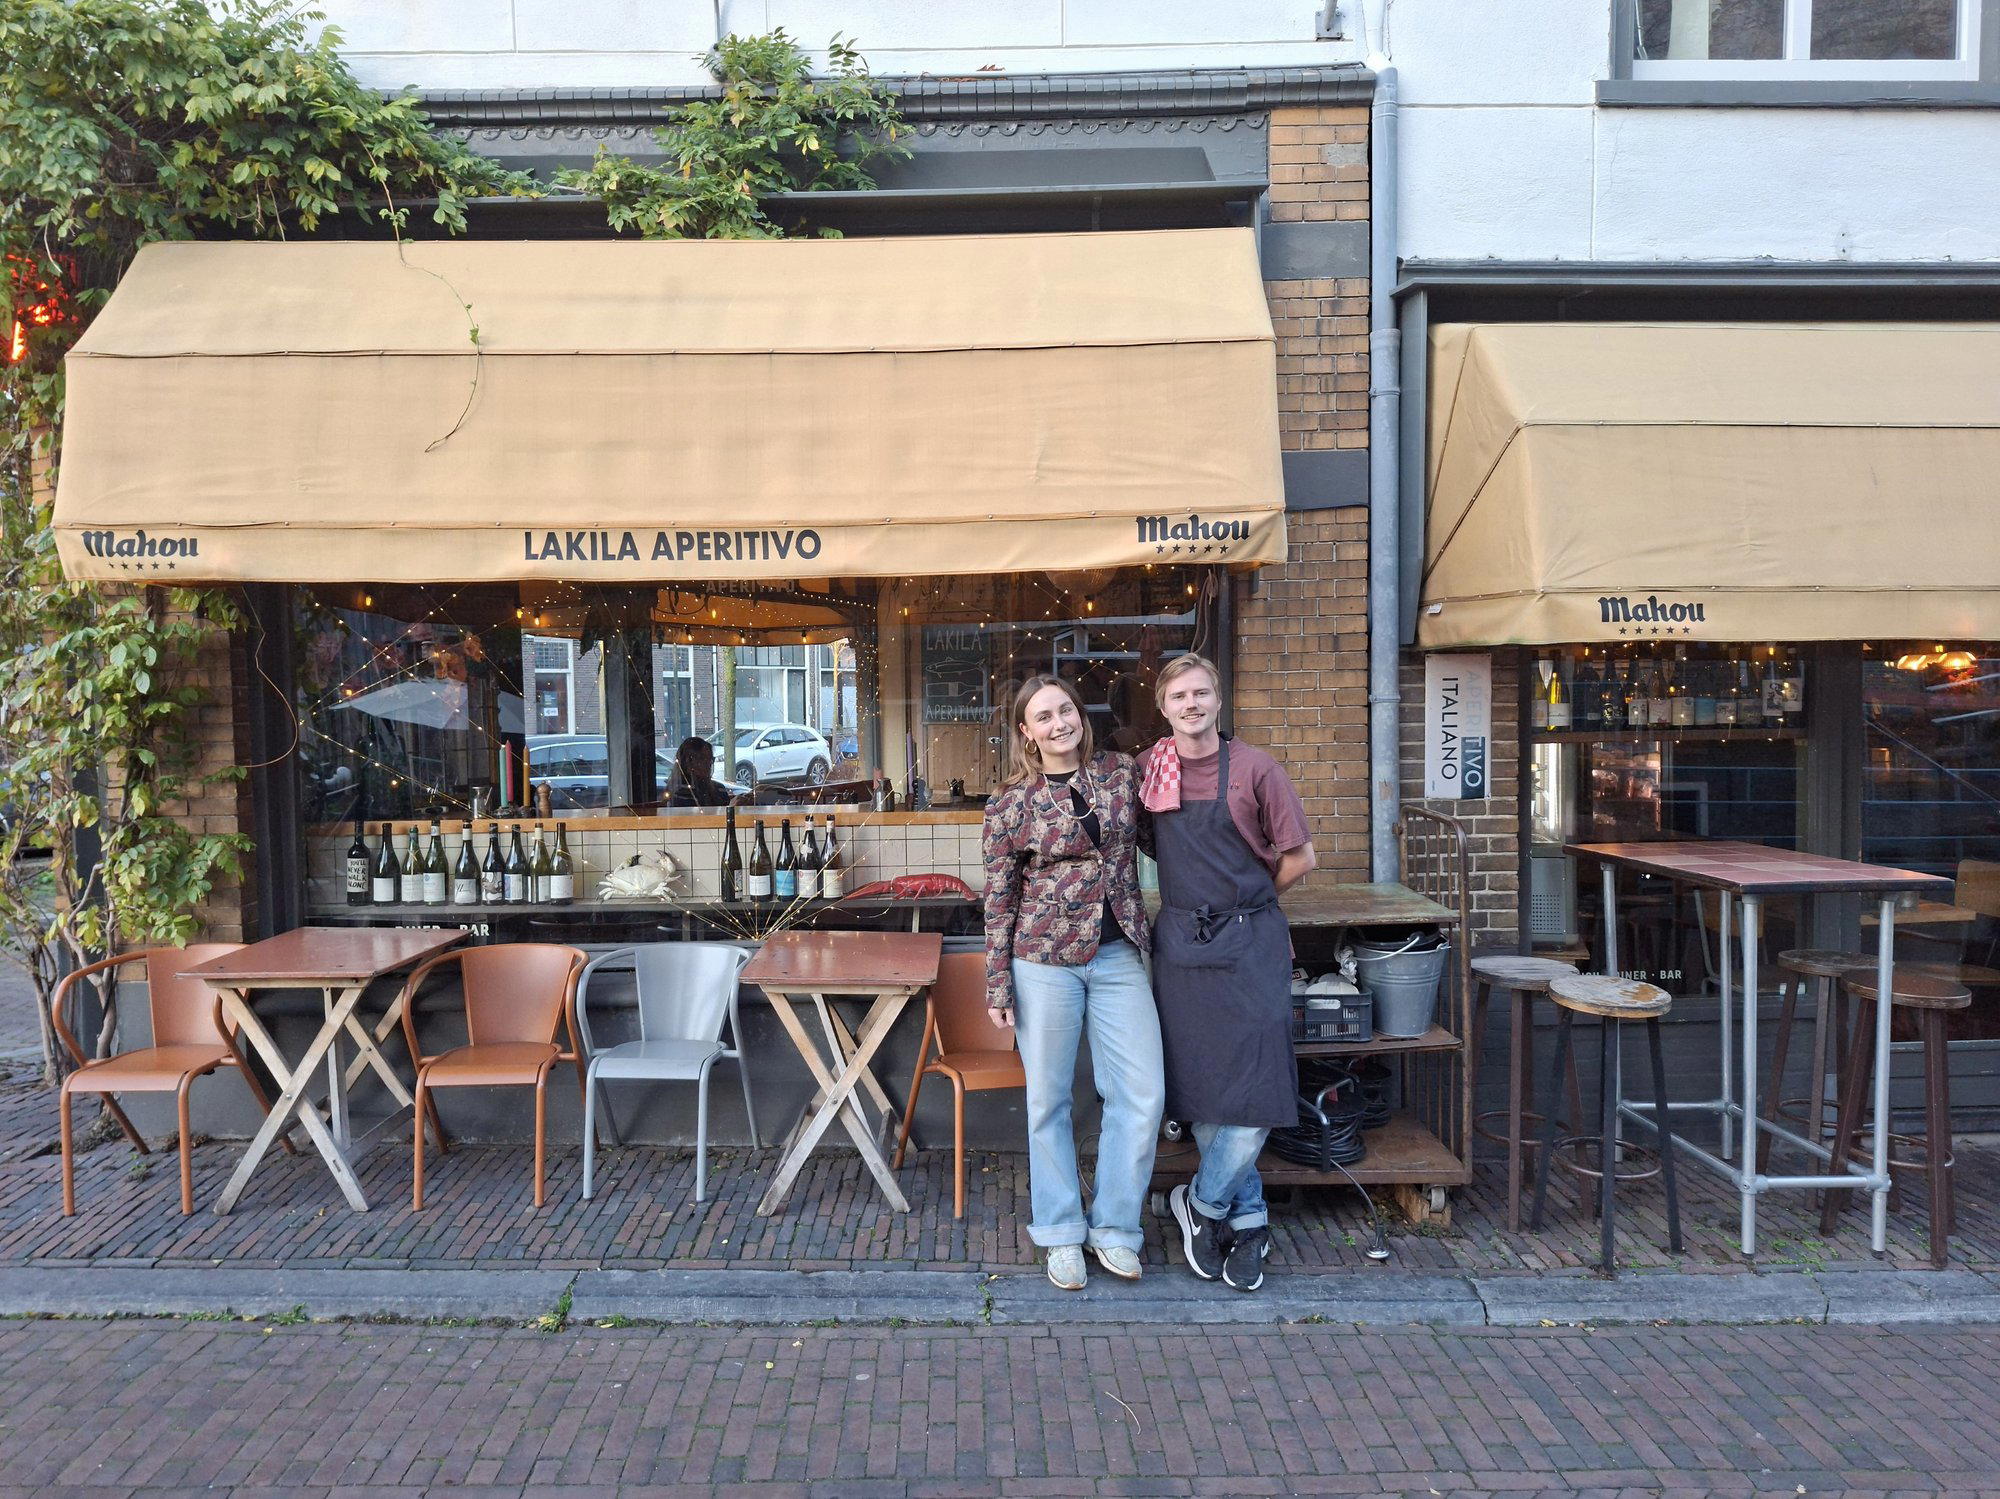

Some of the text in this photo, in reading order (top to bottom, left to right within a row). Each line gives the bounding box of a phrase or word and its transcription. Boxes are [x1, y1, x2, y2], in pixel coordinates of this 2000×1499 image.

[1135, 514, 1250, 543] Mahou
[81, 529, 199, 557] Mahou
[524, 529, 822, 561] LAKILA APERITIVO
[1597, 595, 1706, 622] Mahou
[926, 629, 983, 651] LAKILA
[1441, 677, 1459, 780] ITALIANO
[1464, 671, 1482, 788] APERITIVO
[348, 866, 367, 874] NEVER
[1617, 969, 1682, 980] INER BAR
